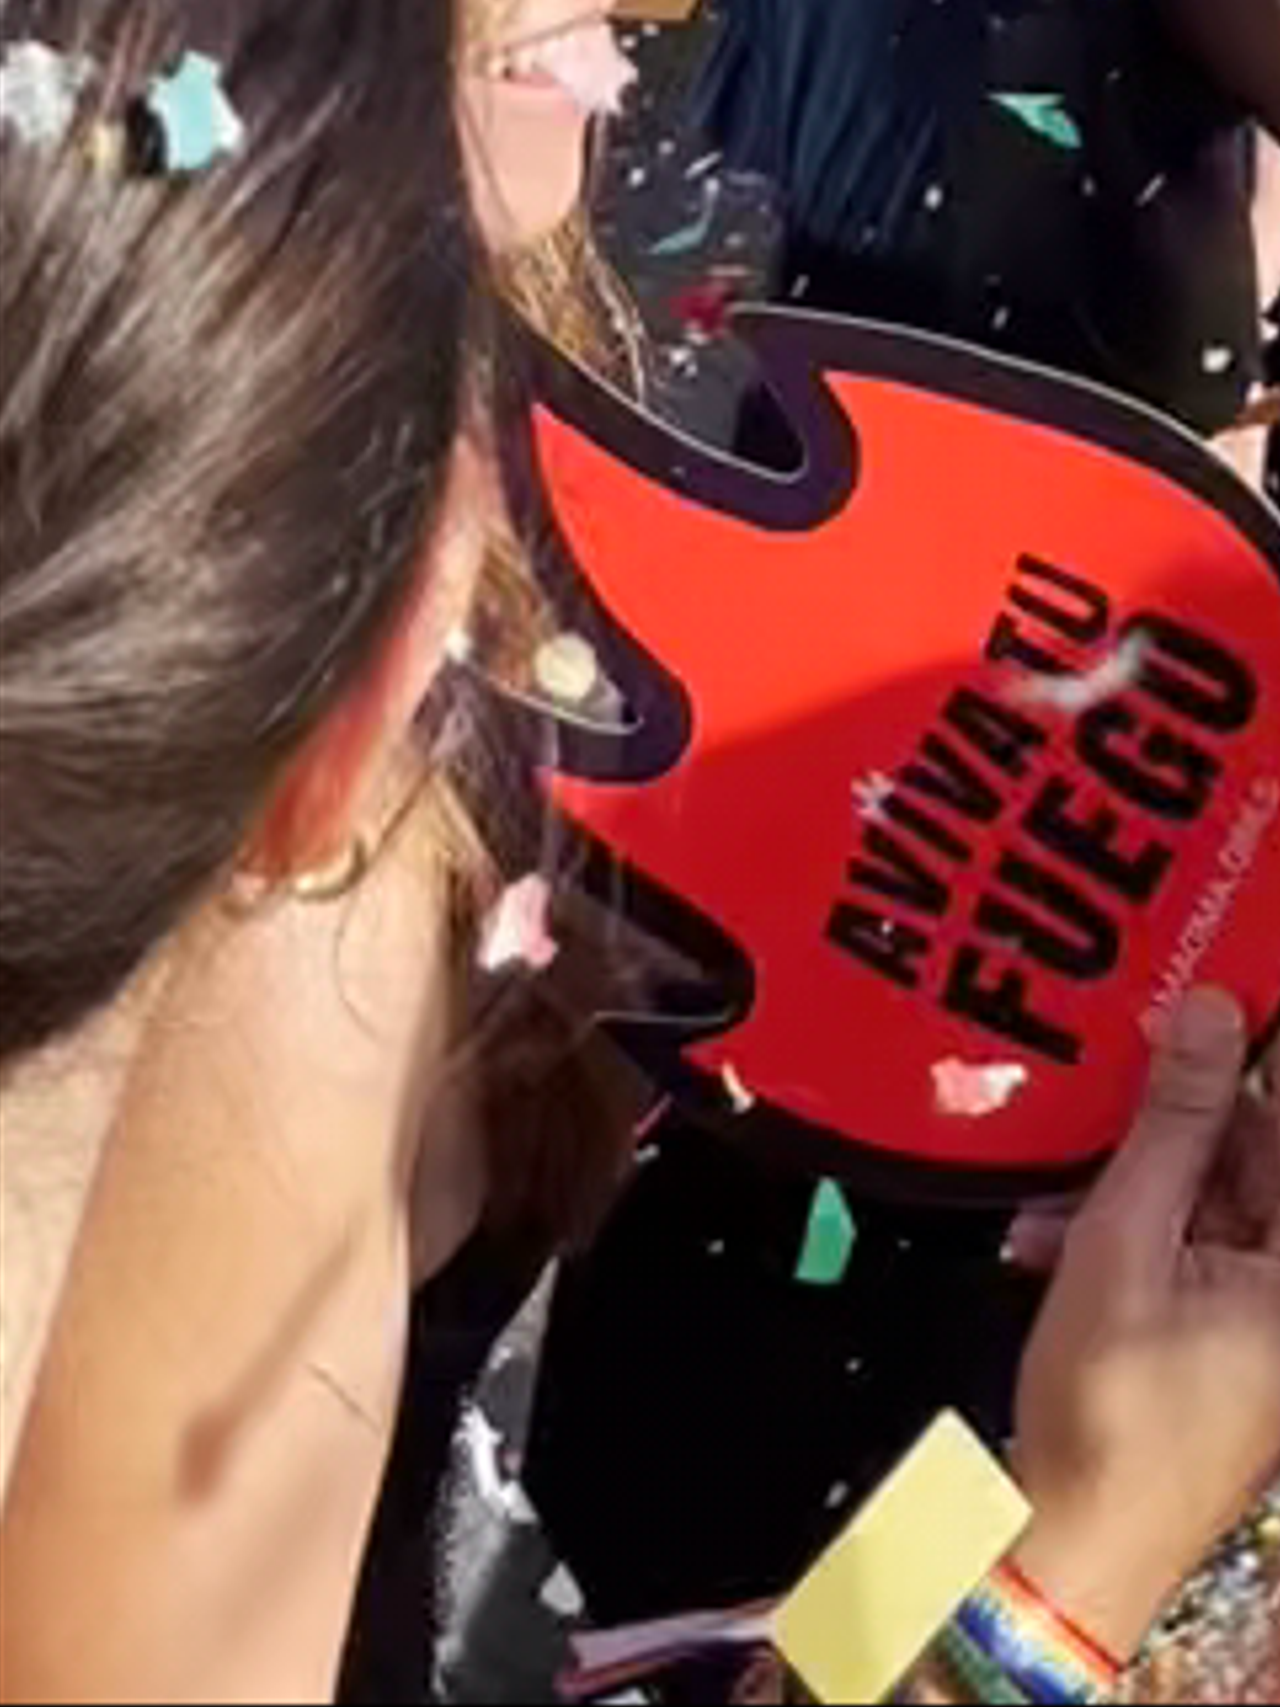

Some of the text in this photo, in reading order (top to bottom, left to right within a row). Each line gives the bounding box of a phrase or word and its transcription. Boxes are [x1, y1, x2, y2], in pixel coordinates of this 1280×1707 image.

[824, 552, 1112, 991] AVIVA TU
[940, 612, 1261, 1066] FUEGO
